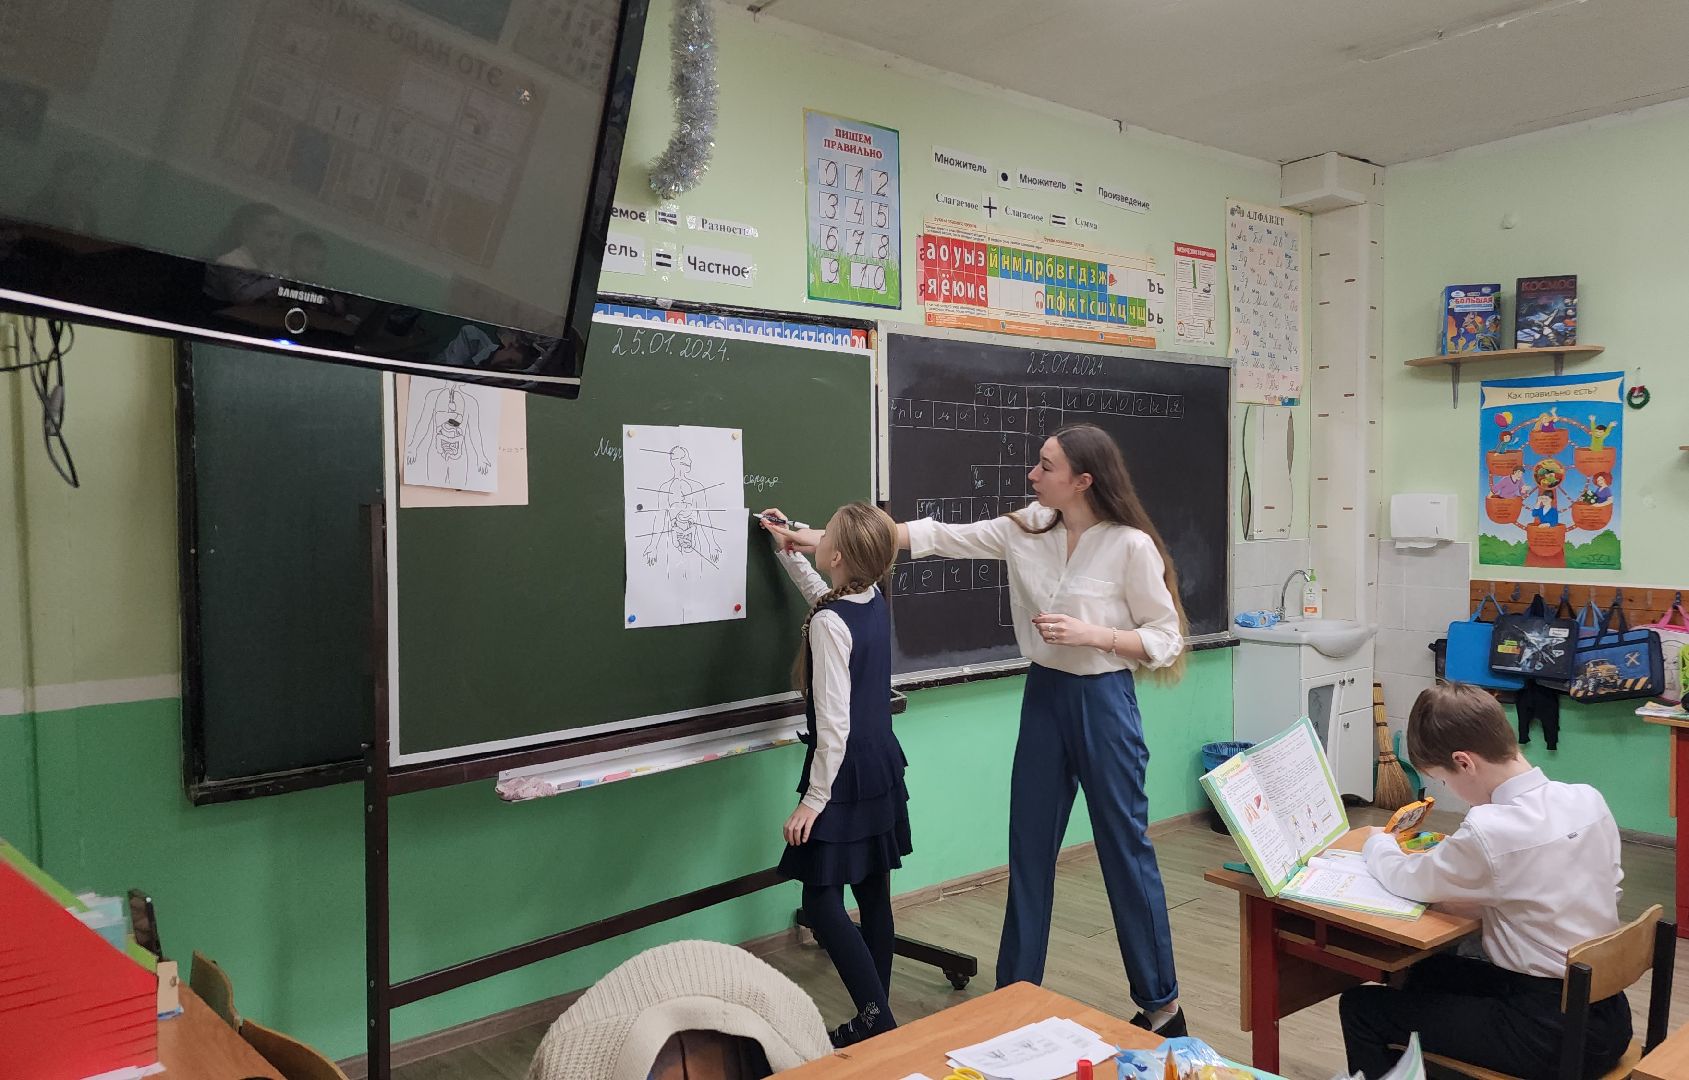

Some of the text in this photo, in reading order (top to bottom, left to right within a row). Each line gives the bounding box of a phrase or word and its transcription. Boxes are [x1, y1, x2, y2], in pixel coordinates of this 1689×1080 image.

[823, 138, 883, 160] ПРАВИЛЬНО
[834, 128, 872, 145] ПИШЕМ
[825, 161, 889, 196] 0 1 2
[934, 152, 987, 174] Множитель
[1019, 173, 1067, 190] Множитель
[1098, 186, 1150, 210] Произведение
[825, 194, 888, 228] 3 4 5
[935, 192, 979, 211] Слагаемое
[1004, 205, 1044, 222] Слагаемое
[825, 226, 889, 259] 6 7 8
[606, 242, 638, 258] ель
[687, 255, 750, 278] Частное
[827, 258, 886, 290] 9 10
[278, 286, 324, 304] SAMSUNG
[1507, 386, 1599, 400] Как правильно есть?
